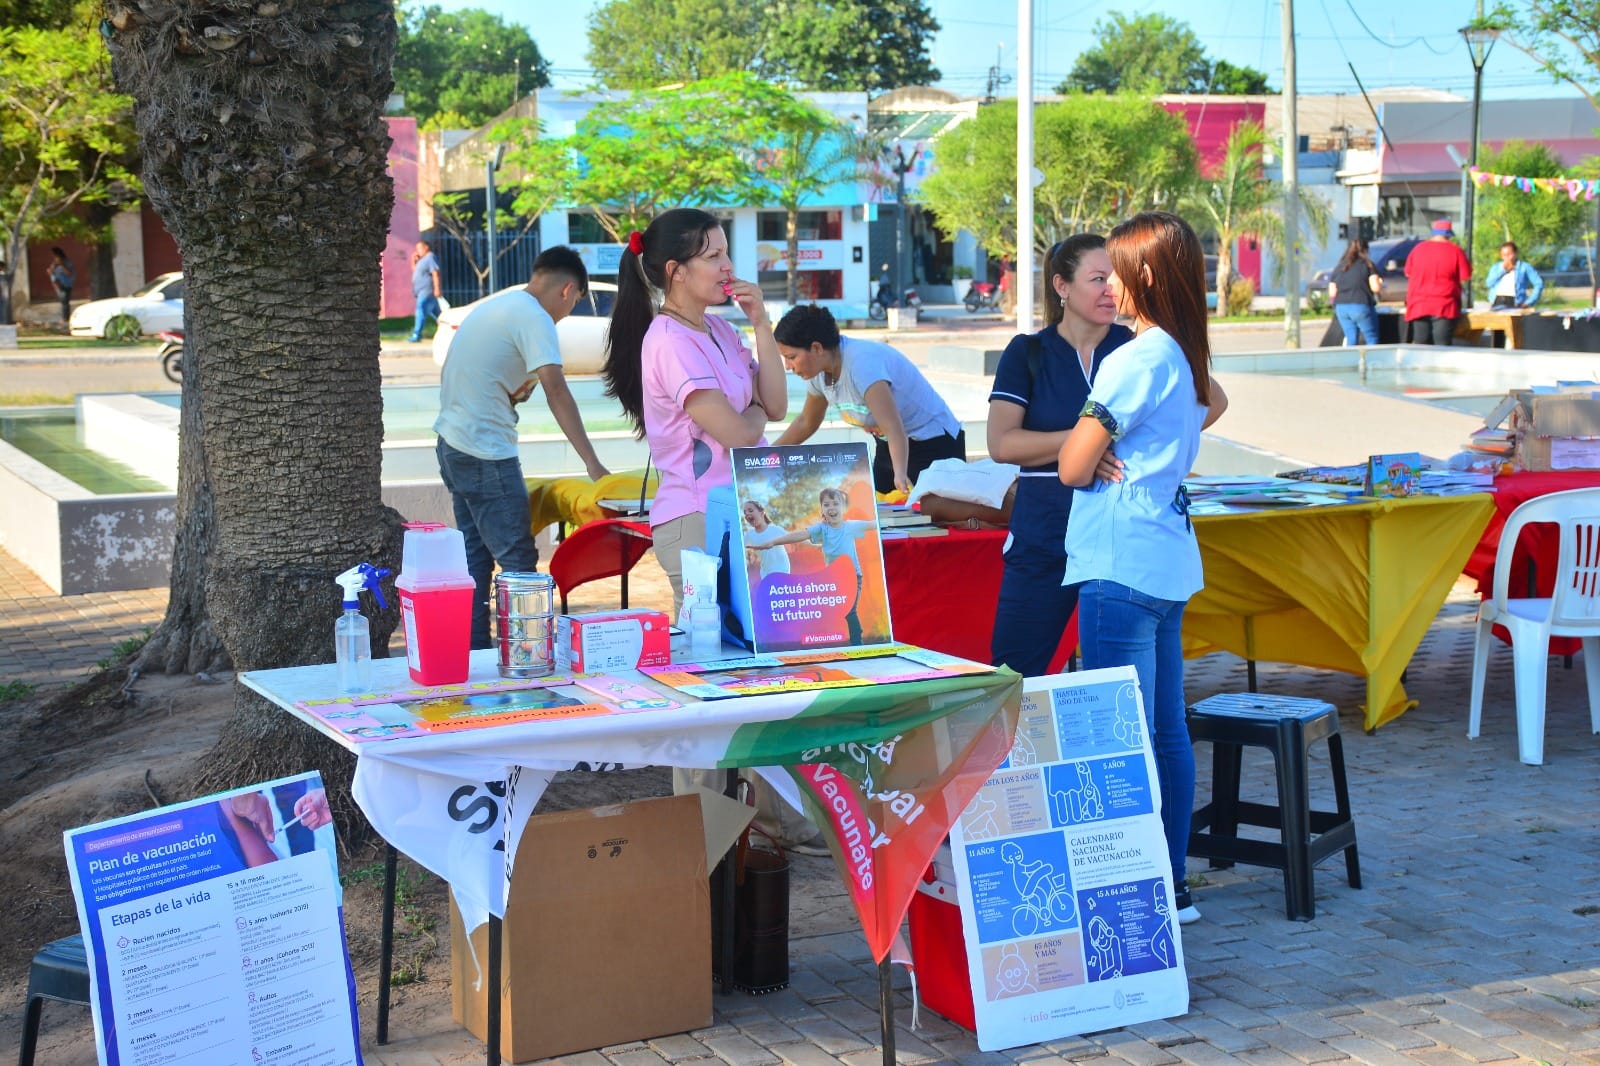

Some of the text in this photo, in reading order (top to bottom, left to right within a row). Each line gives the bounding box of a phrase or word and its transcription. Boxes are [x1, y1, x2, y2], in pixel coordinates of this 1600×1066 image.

[769, 582, 837, 595] Actuá ahora
[770, 595, 847, 610] para proteger
[771, 610, 822, 621] tu futuro
[805, 633, 843, 643] #Vacunate
[1055, 689, 1077, 698] HASTA
[1057, 697, 1072, 706] AÑO
[1108, 759, 1125, 767] AÑOS
[983, 778, 999, 786] ASTA
[1001, 775, 1014, 783] LOS
[1021, 771, 1038, 779] AÑOS
[812, 762, 874, 890] Vacunate
[1071, 832, 1124, 845] CALENDARIO
[88, 831, 215, 873] Plan de vacunación
[976, 846, 995, 855] AÑOS
[1072, 843, 1115, 855] NACIONAL
[1073, 847, 1141, 866] DE VACUNACIÓN
[136, 863, 161, 873] gratuitas
[94, 893, 107, 901] Son
[108, 886, 141, 898] obligatorias
[1119, 884, 1137, 893] AÑOS
[111, 890, 210, 927] Etapas de la vida
[156, 928, 180, 937] nacidos
[1043, 938, 1062, 946] AÑOS
[126, 964, 147, 973] meses
[133, 1008, 153, 1017] meses
